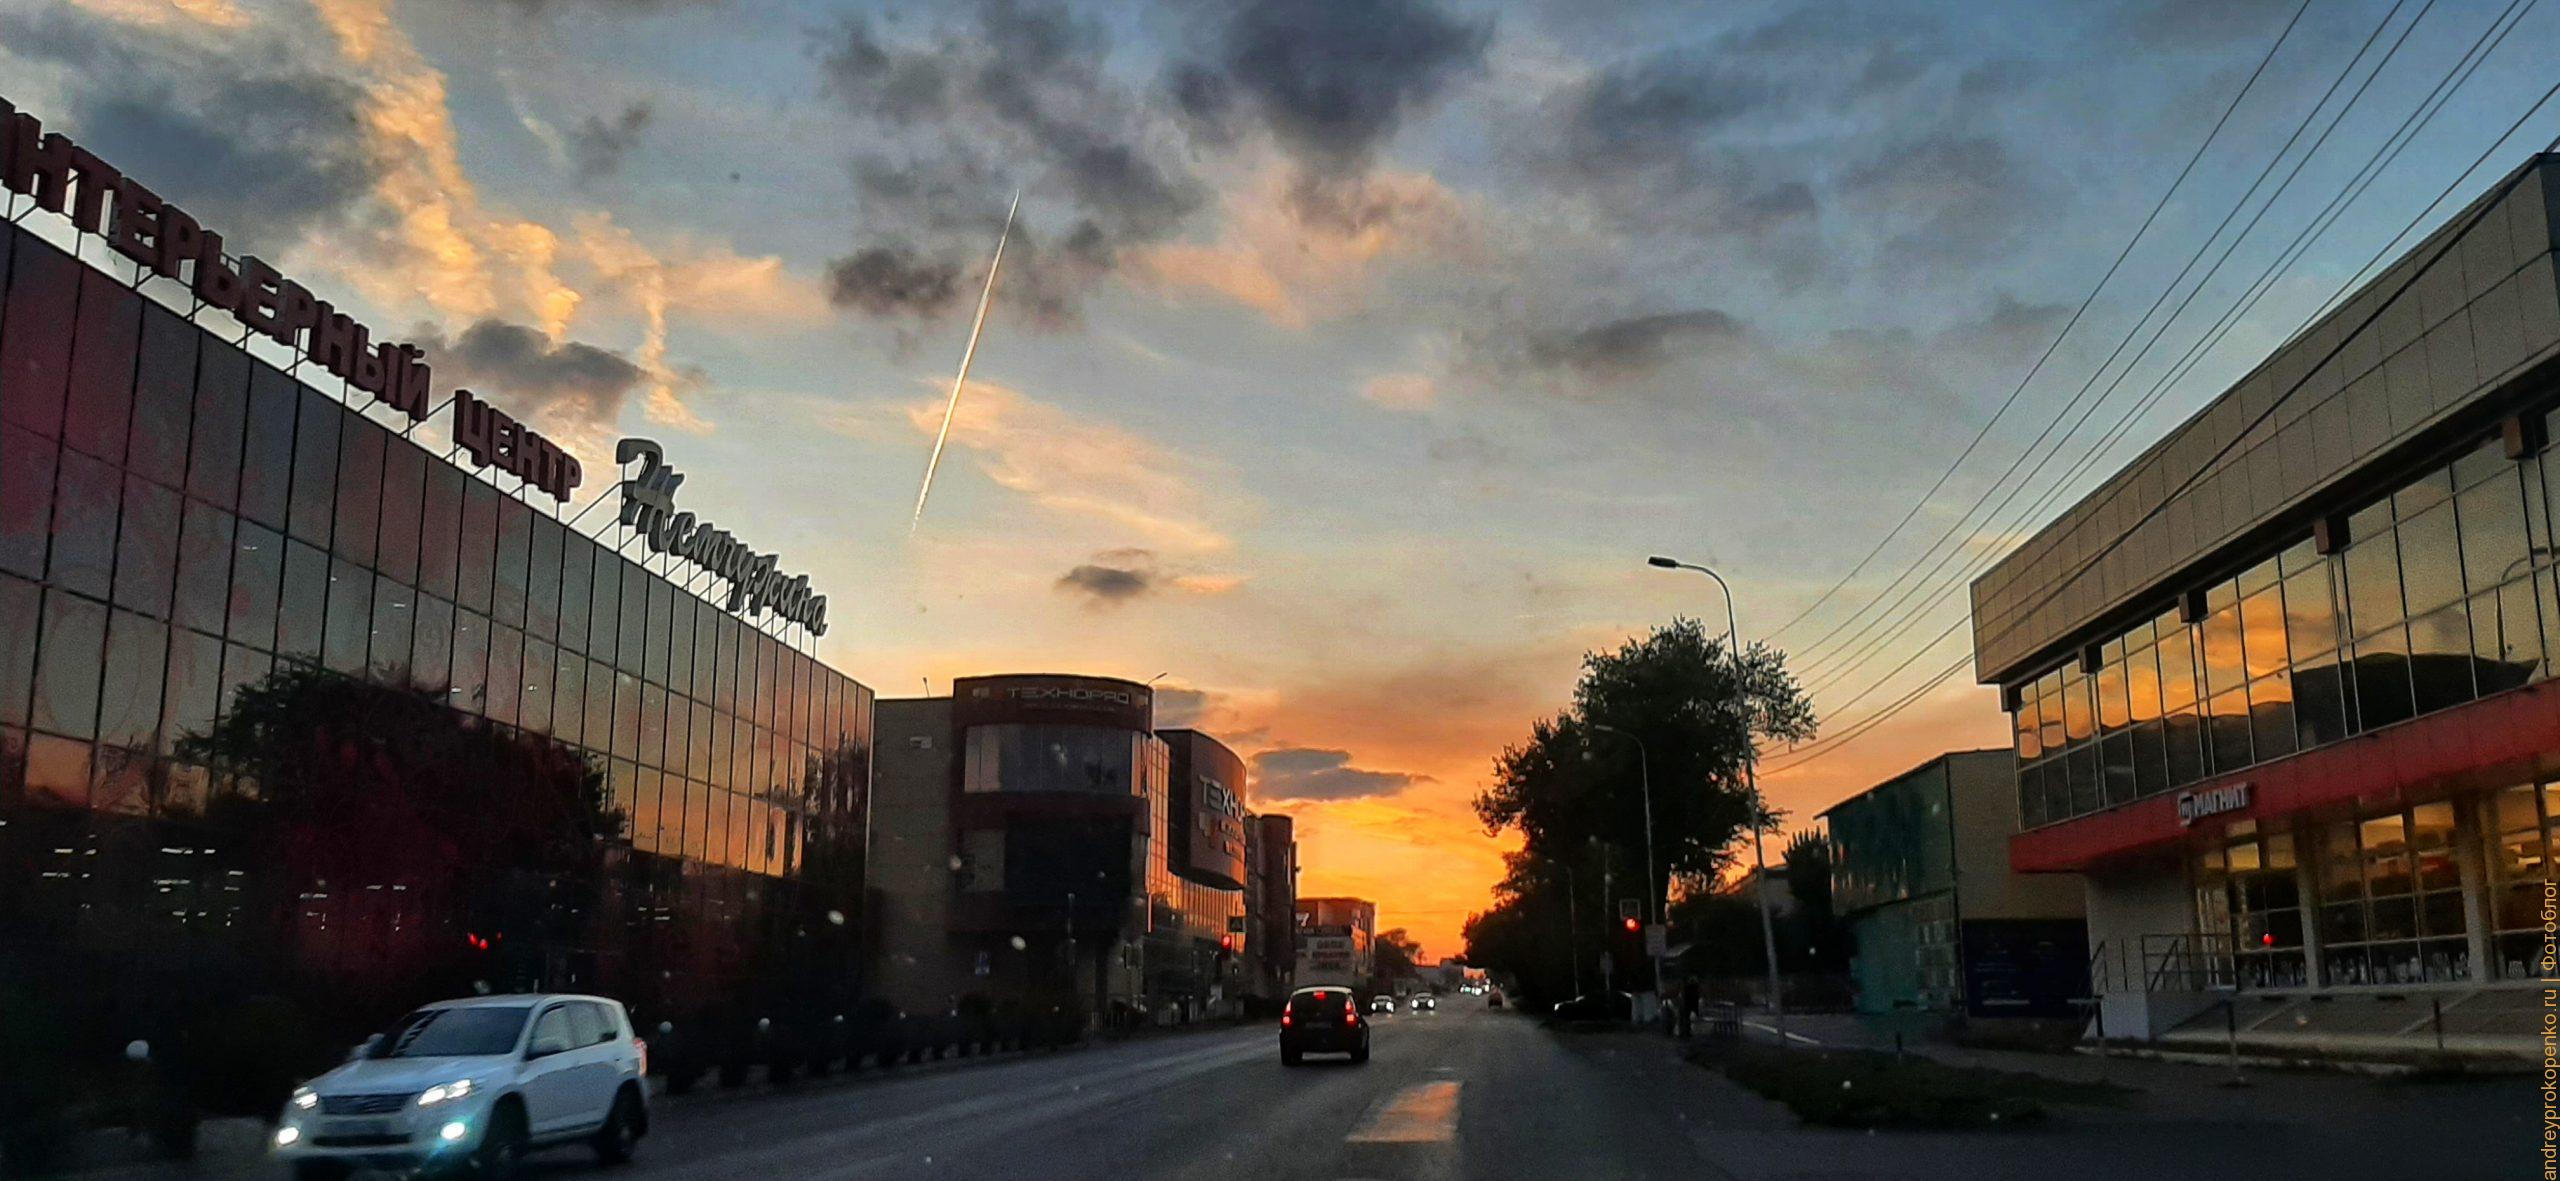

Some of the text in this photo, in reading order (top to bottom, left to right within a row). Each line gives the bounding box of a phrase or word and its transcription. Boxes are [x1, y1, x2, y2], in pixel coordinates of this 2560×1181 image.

[0, 97, 583, 503] НТЕРЬЕРНЫЙ ЦЕНТР
[615, 438, 828, 636] Жемчужина
[2193, 782, 2248, 818] МАГНИТ
